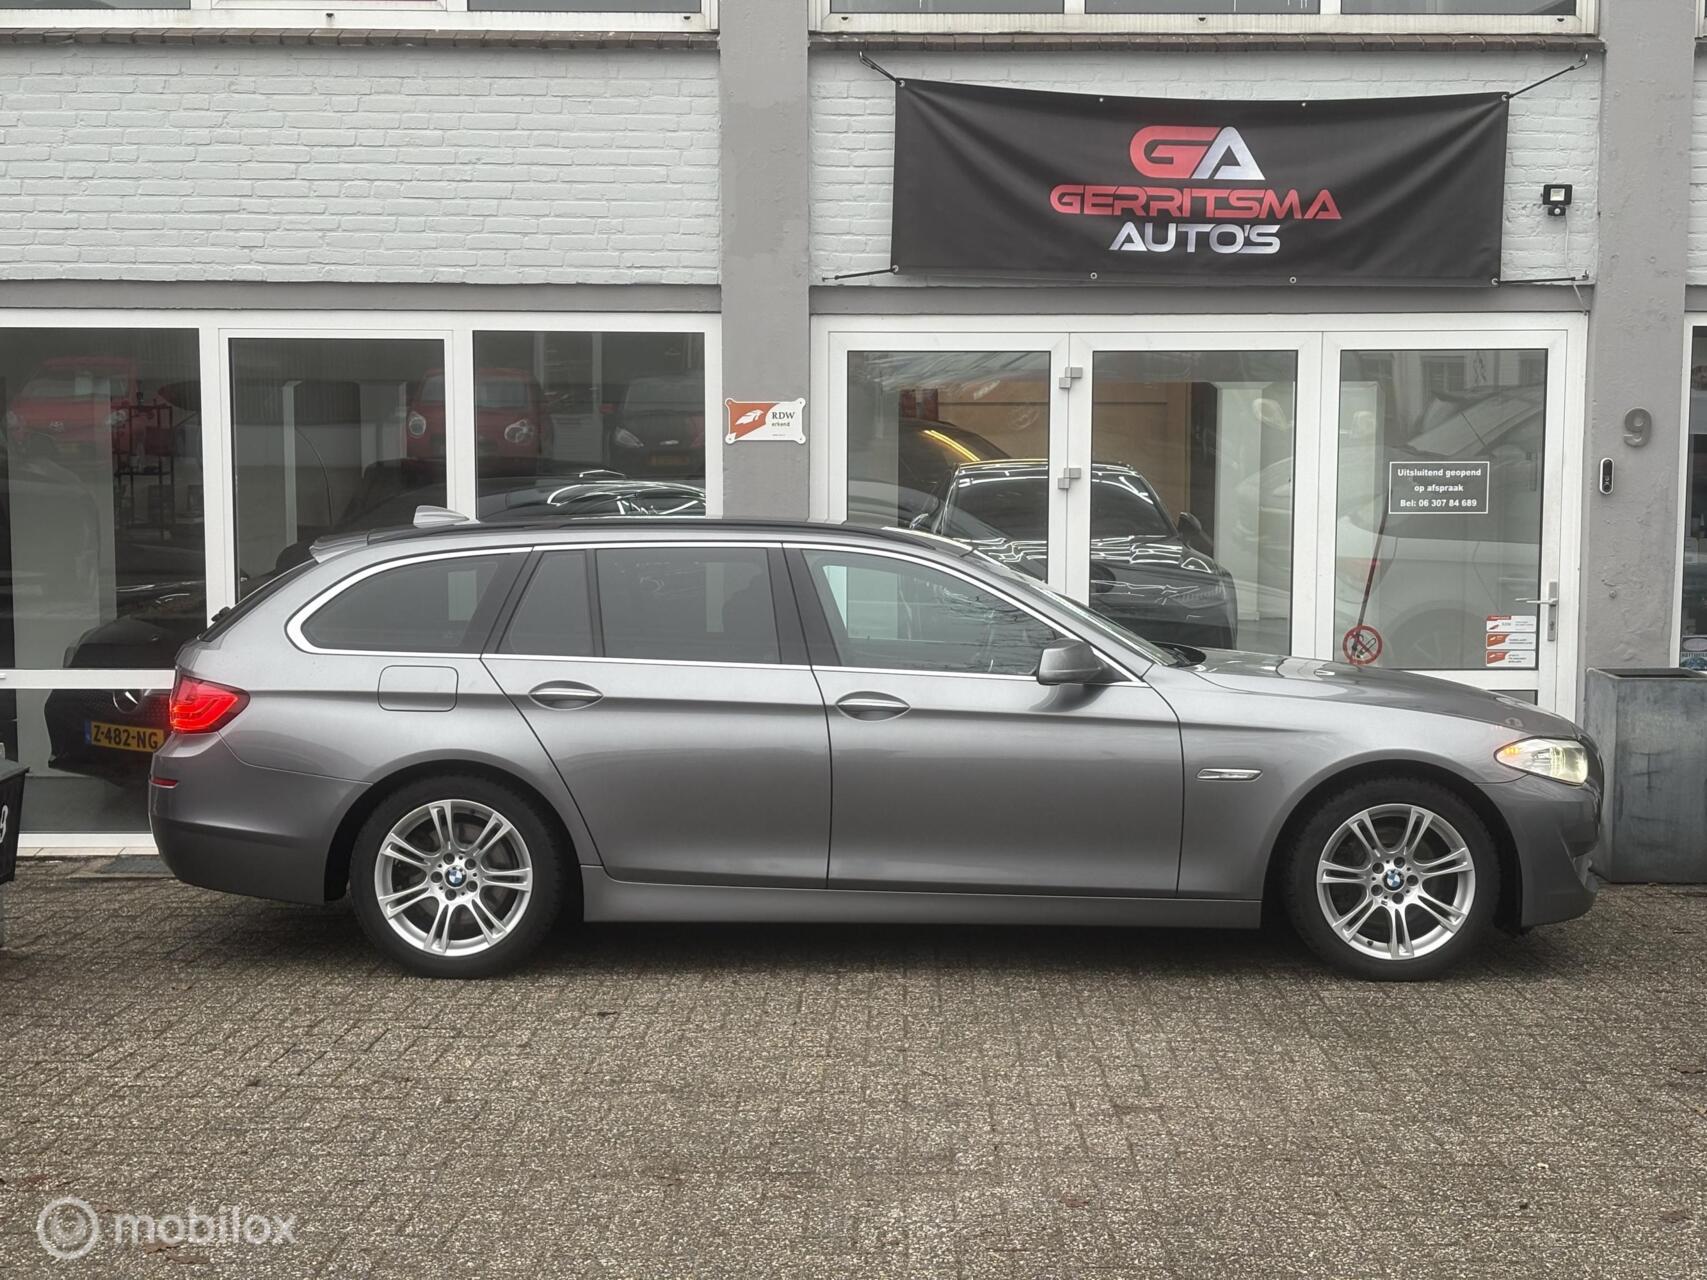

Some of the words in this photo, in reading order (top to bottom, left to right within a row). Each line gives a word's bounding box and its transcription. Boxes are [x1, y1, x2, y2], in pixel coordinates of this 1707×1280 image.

[1129, 125, 1265, 180] GA
[1049, 184, 1342, 220] GERRITSMA
[1108, 221, 1281, 254] AUTO'S
[771, 411, 796, 420] RDW
[1623, 407, 1652, 448] 9
[1397, 468, 1444, 476] Uitsluitend
[1445, 468, 1482, 478] geopend
[1414, 485, 1425, 493] op
[1426, 483, 1464, 493] afspraak
[1400, 499, 1417, 507] Bel:
[1418, 499, 1429, 507] 06
[1431, 499, 1447, 507] 307
[1448, 499, 1459, 507] 84
[1461, 499, 1477, 507] 689
[93, 724, 158, 750] Z-482-NG
